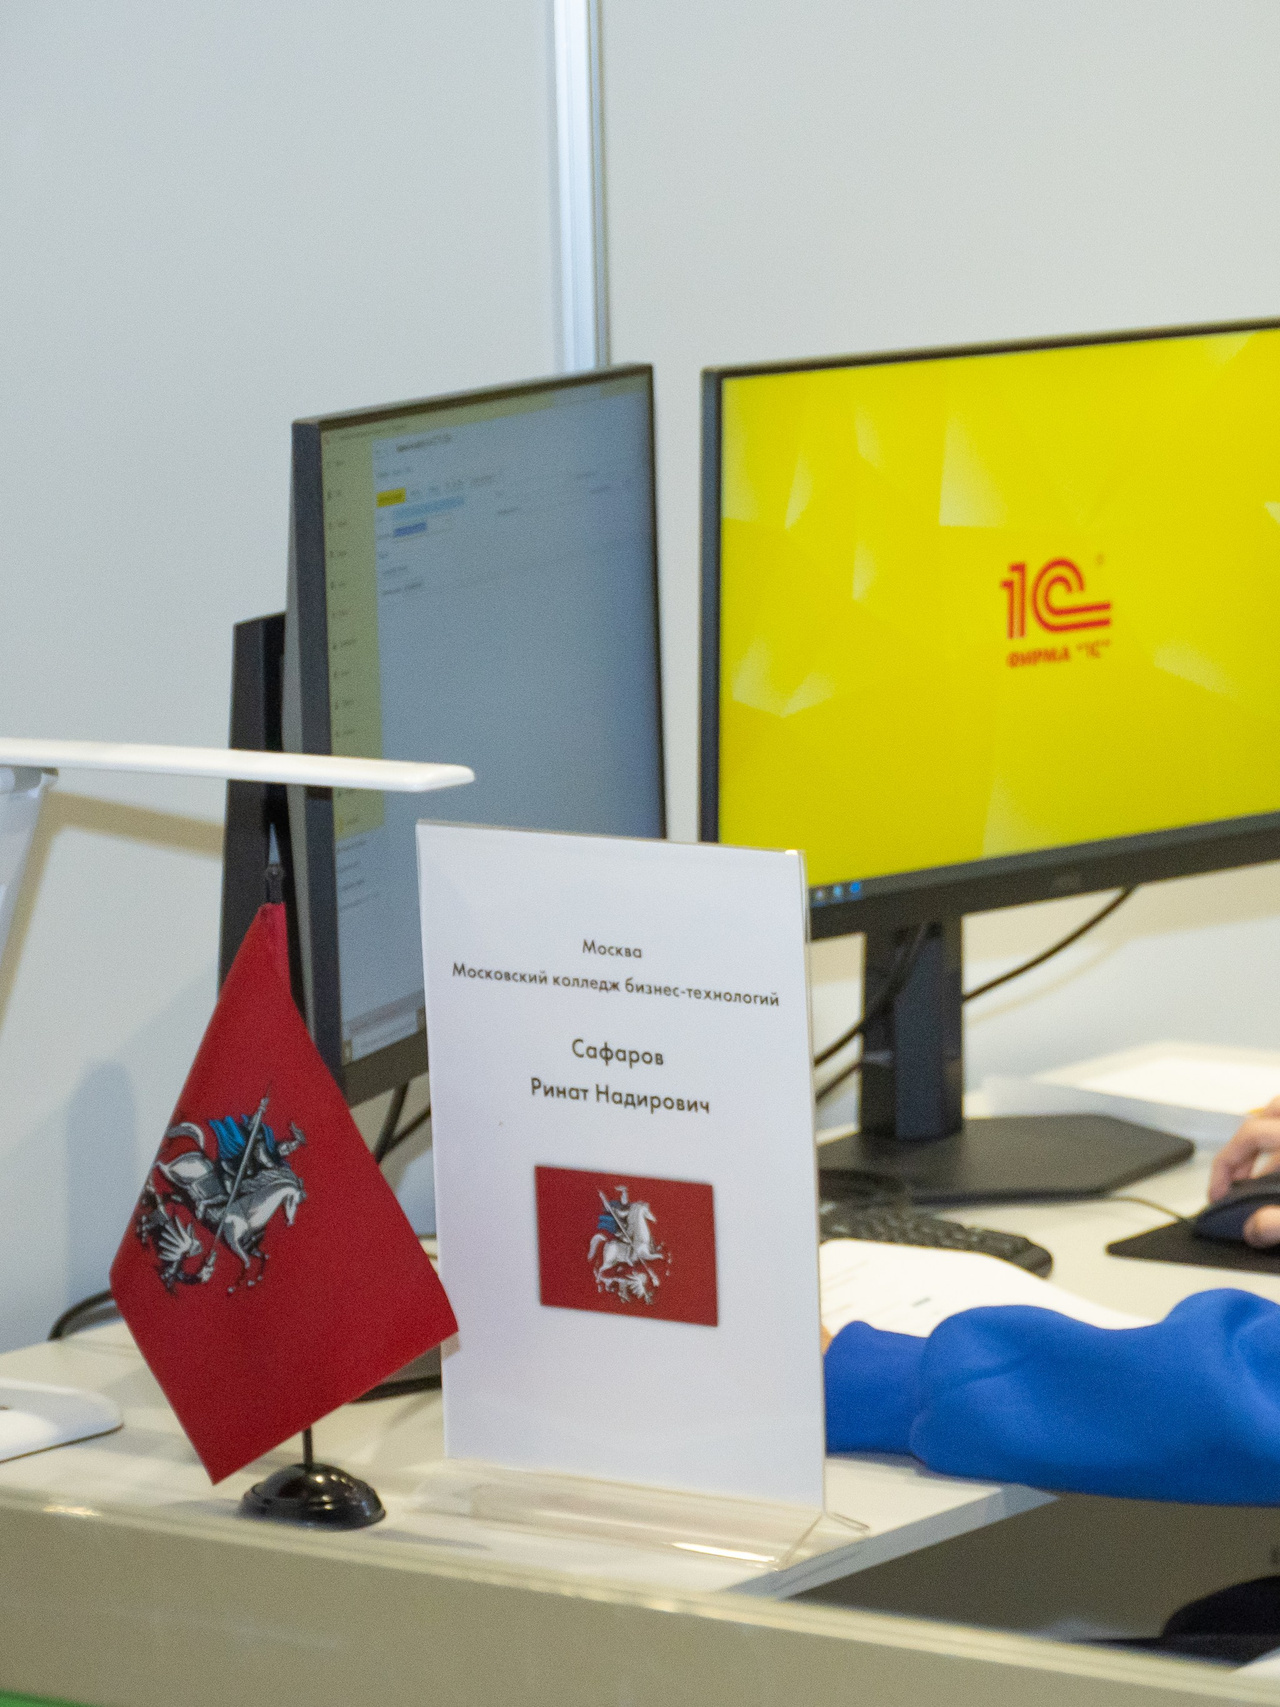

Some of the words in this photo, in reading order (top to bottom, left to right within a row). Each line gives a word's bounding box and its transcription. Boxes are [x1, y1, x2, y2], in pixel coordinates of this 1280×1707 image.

[582, 938, 643, 959] Москва
[452, 962, 548, 985] Московский
[552, 975, 620, 993] колледж
[625, 977, 780, 1007] бизнес-технологий
[571, 1038, 664, 1069] Сафаров
[530, 1077, 589, 1101] Ринат
[595, 1084, 710, 1115] Надирович
